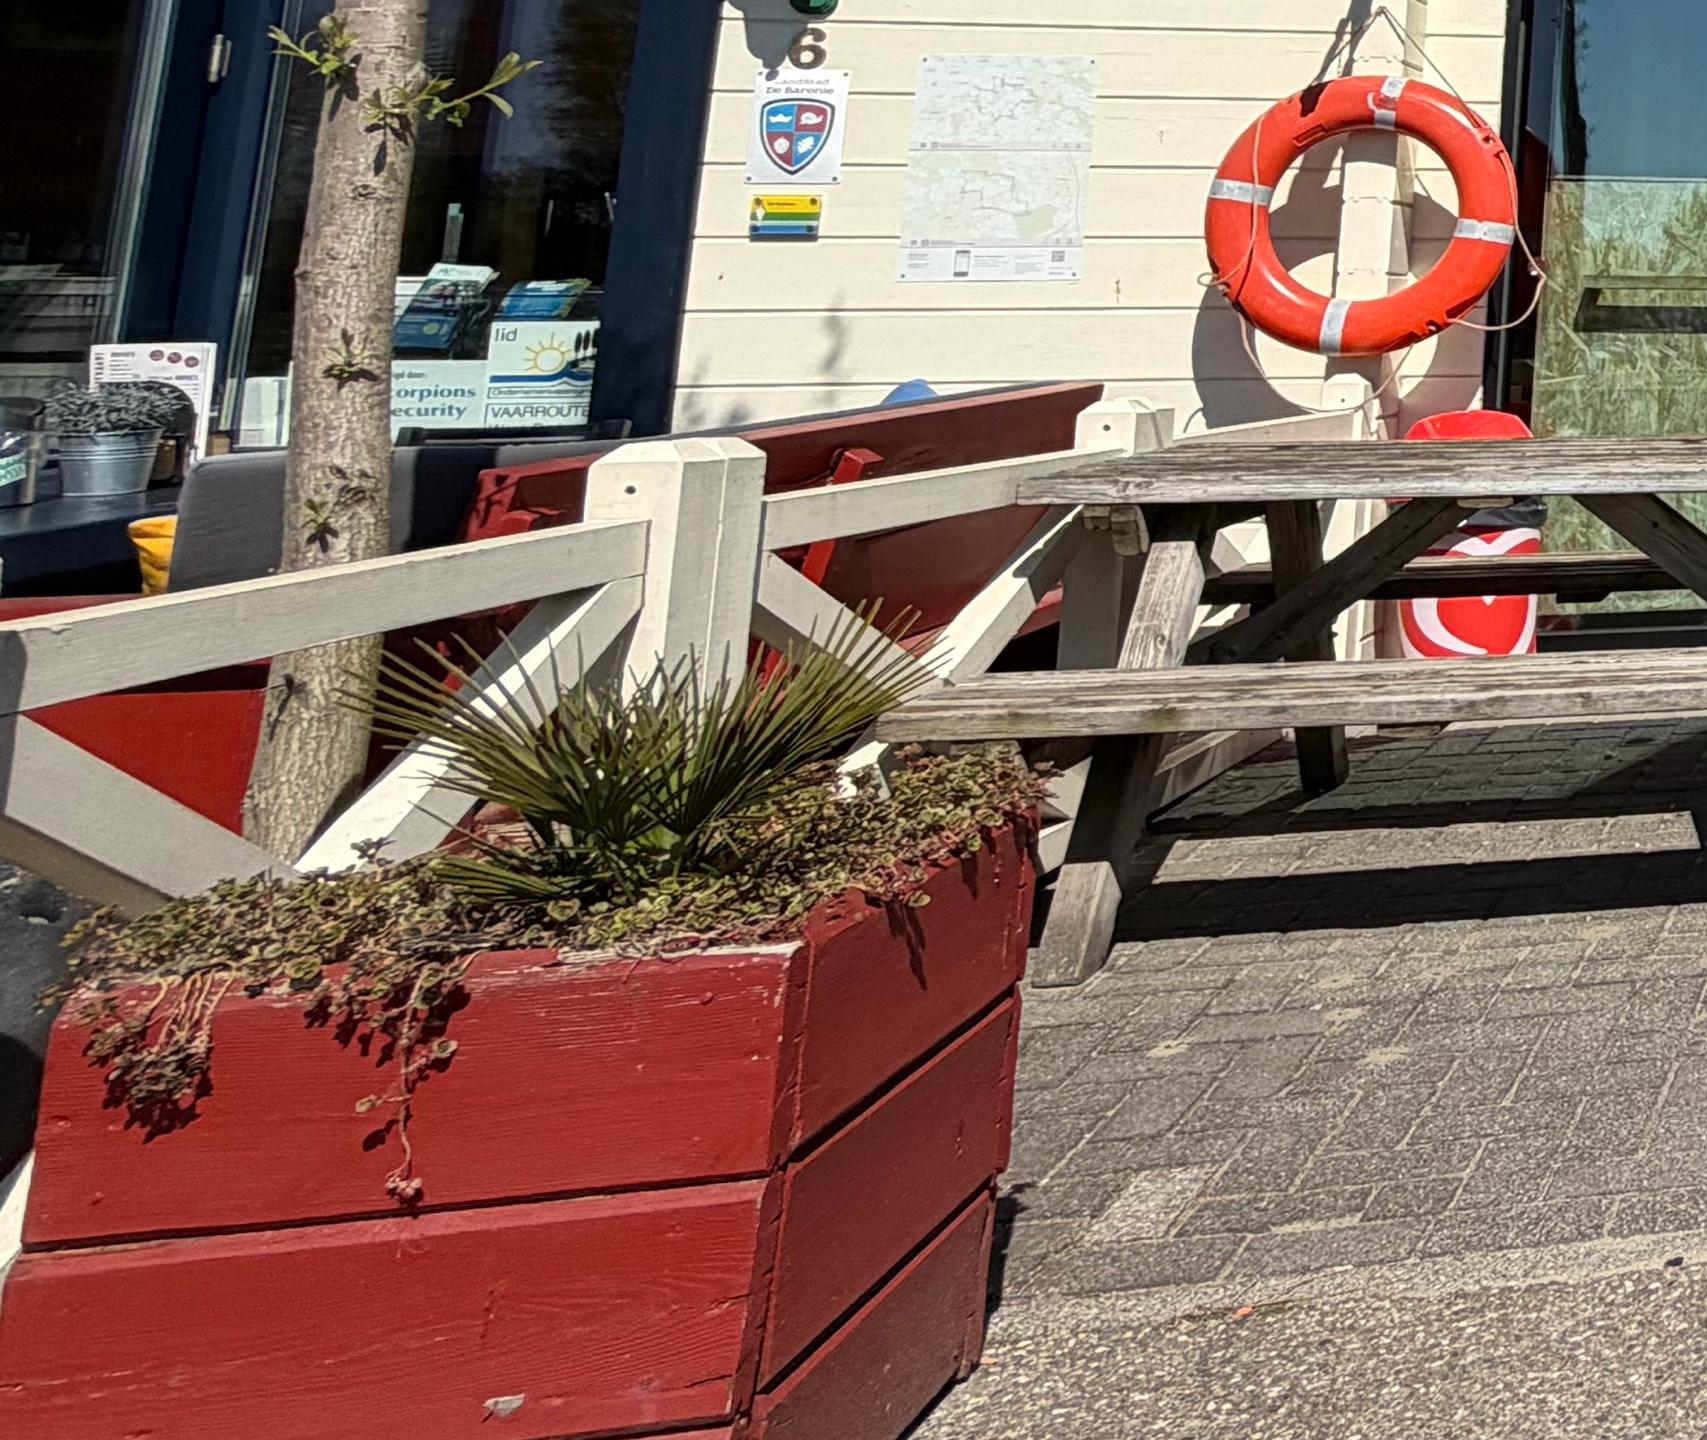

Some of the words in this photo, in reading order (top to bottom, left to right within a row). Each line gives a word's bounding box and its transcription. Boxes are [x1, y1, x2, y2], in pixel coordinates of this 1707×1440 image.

[788, 27, 827, 70] 6
[494, 327, 518, 342] lid
[394, 384, 477, 403] orpions
[390, 404, 468, 420] ecurity
[491, 404, 588, 419] VAARROUTE
